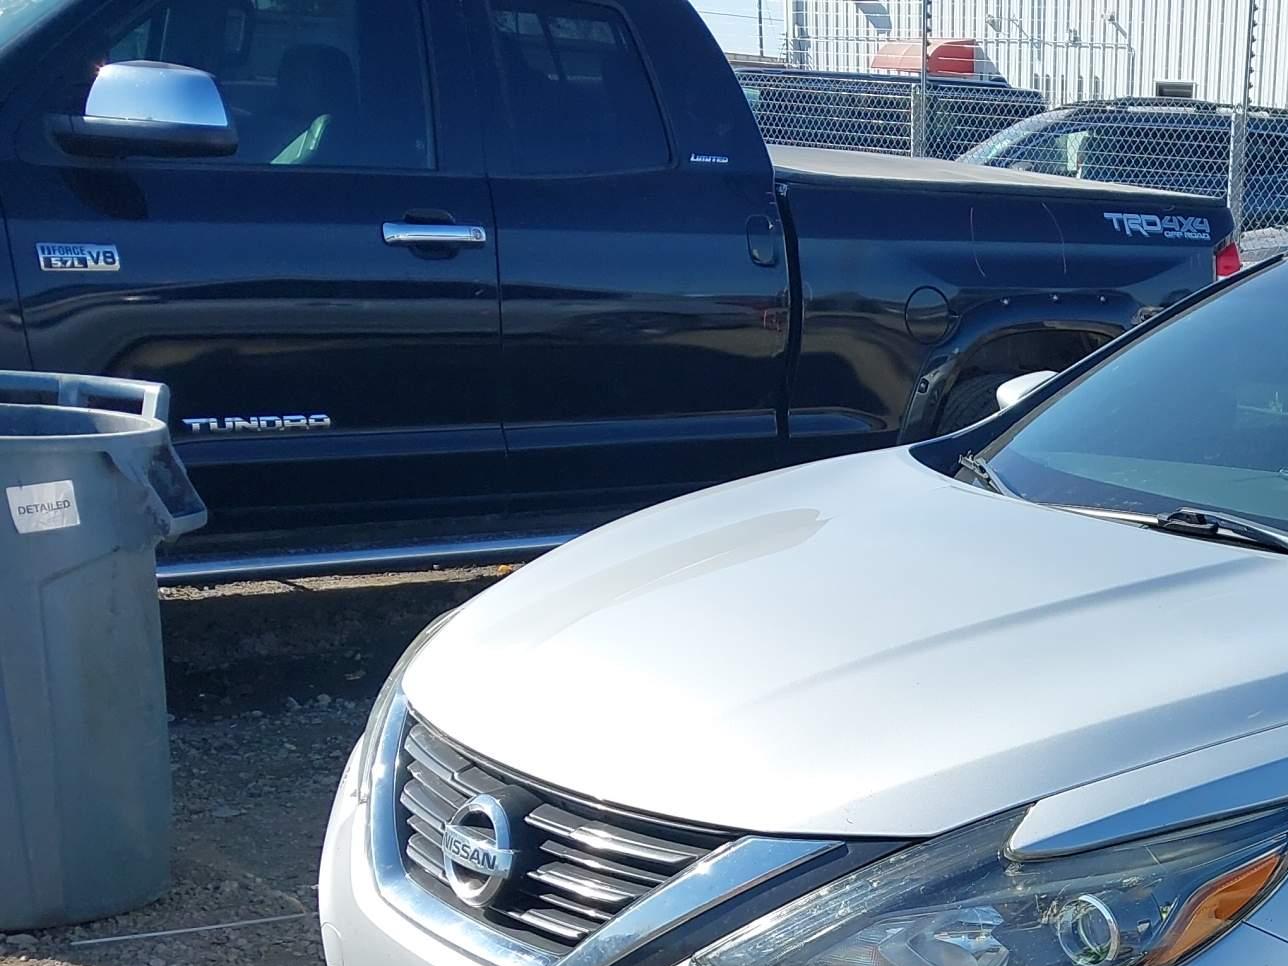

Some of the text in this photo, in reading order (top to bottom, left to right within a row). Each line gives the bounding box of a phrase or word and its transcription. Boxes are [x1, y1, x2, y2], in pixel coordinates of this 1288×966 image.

[1103, 212, 1162, 238] TRD
[1184, 231, 1212, 241] ROAD
[87, 249, 117, 266] V8
[182, 414, 331, 432] TUNDRA
[17, 499, 71, 515] DETAILED
[443, 831, 497, 870] NISSAN
